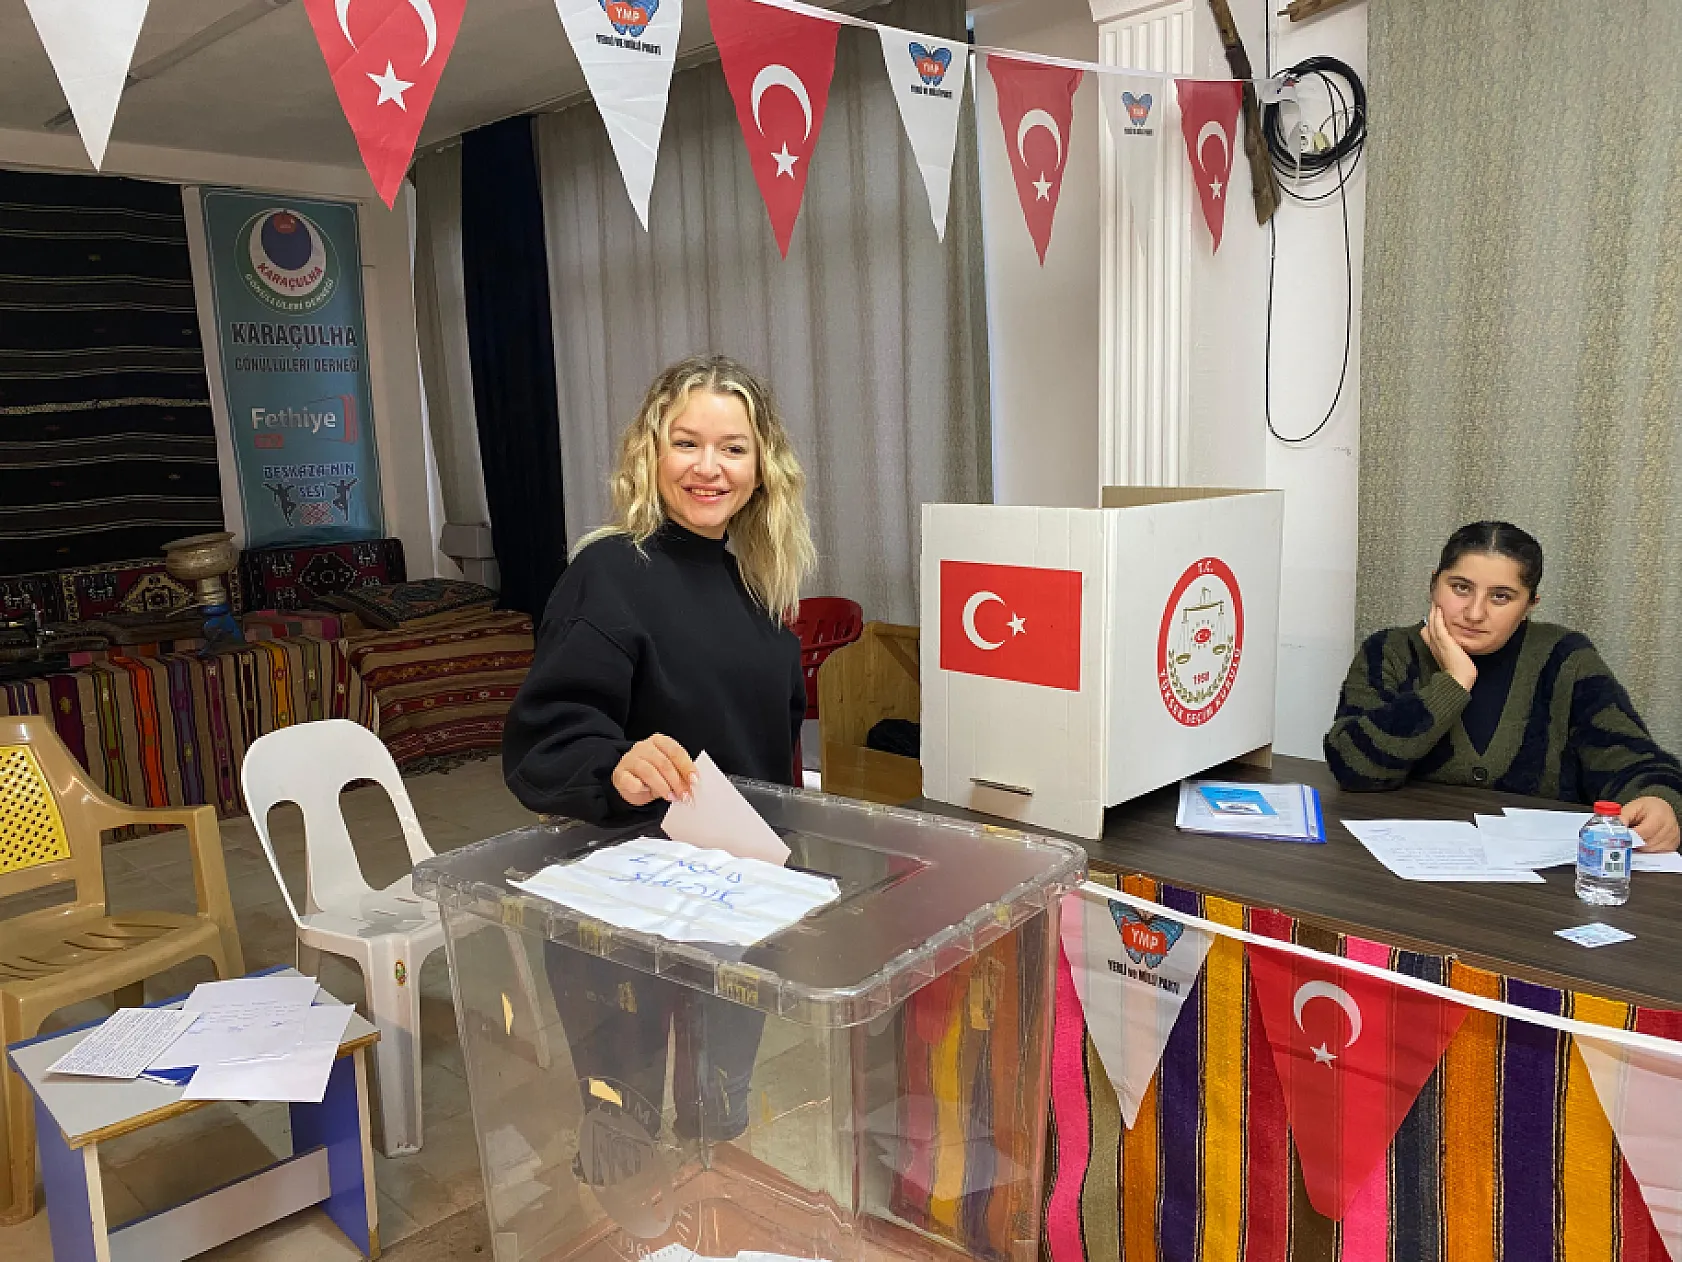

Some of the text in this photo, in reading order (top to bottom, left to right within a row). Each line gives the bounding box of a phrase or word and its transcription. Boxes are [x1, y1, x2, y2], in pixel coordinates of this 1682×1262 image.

[615, 6, 640, 22] YMP
[257, 262, 323, 291] KARAÇULHA
[230, 321, 358, 352] KARAÇULHA
[251, 407, 336, 434] Fethiye
[1131, 928, 1158, 950] YMP
